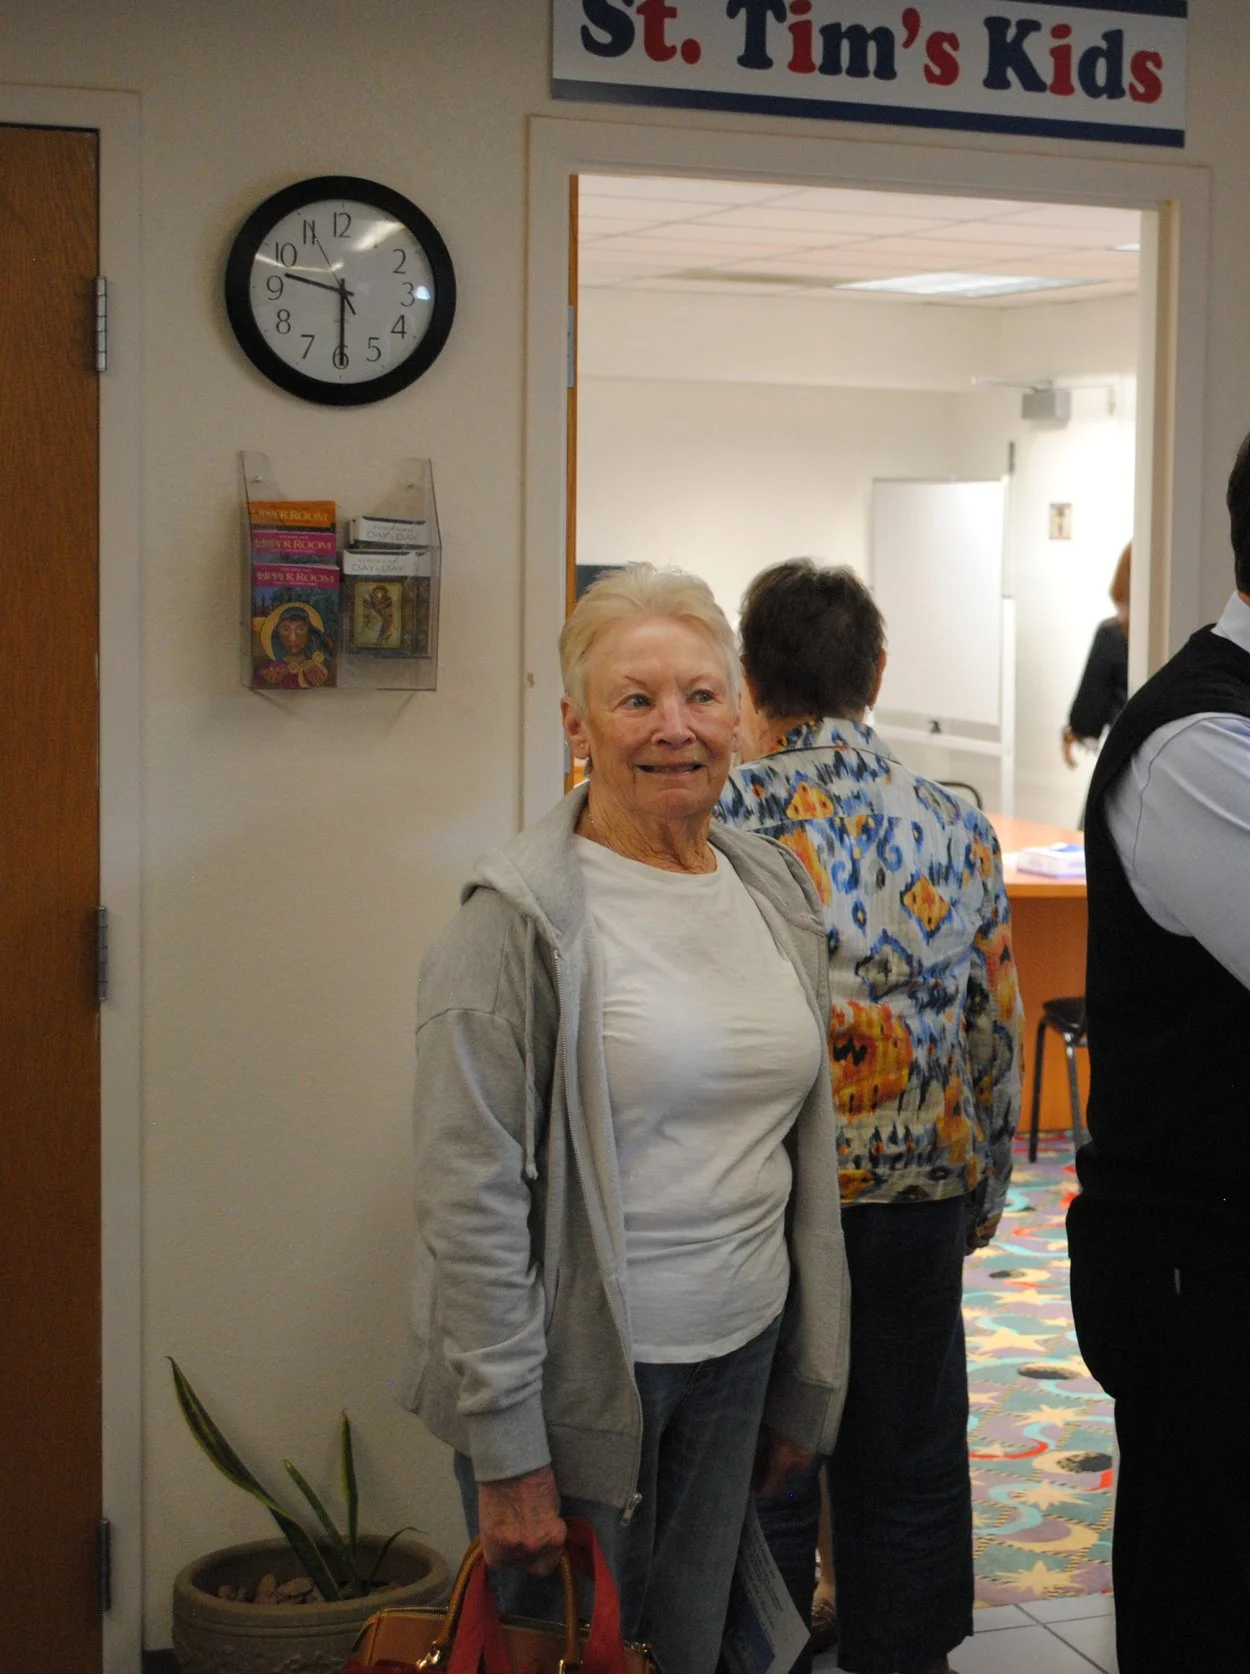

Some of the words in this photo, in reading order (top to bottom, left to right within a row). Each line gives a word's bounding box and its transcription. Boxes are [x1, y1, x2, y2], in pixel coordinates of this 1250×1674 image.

[580, 0, 702, 64] St.
[726, 0, 960, 86] Tim's
[982, 16, 1164, 104] Kids
[303, 219, 316, 245] 11
[333, 212, 352, 238] 12
[275, 242, 298, 267] 10
[393, 248, 407, 275] 2
[266, 275, 284, 301] 9
[400, 281, 416, 308] 3
[275, 308, 292, 335] 8
[391, 314, 407, 339] 4
[300, 334, 315, 360] 7
[332, 344, 350, 370] 6
[366, 336, 382, 362] 5
[298, 573, 335, 583] ROOM
